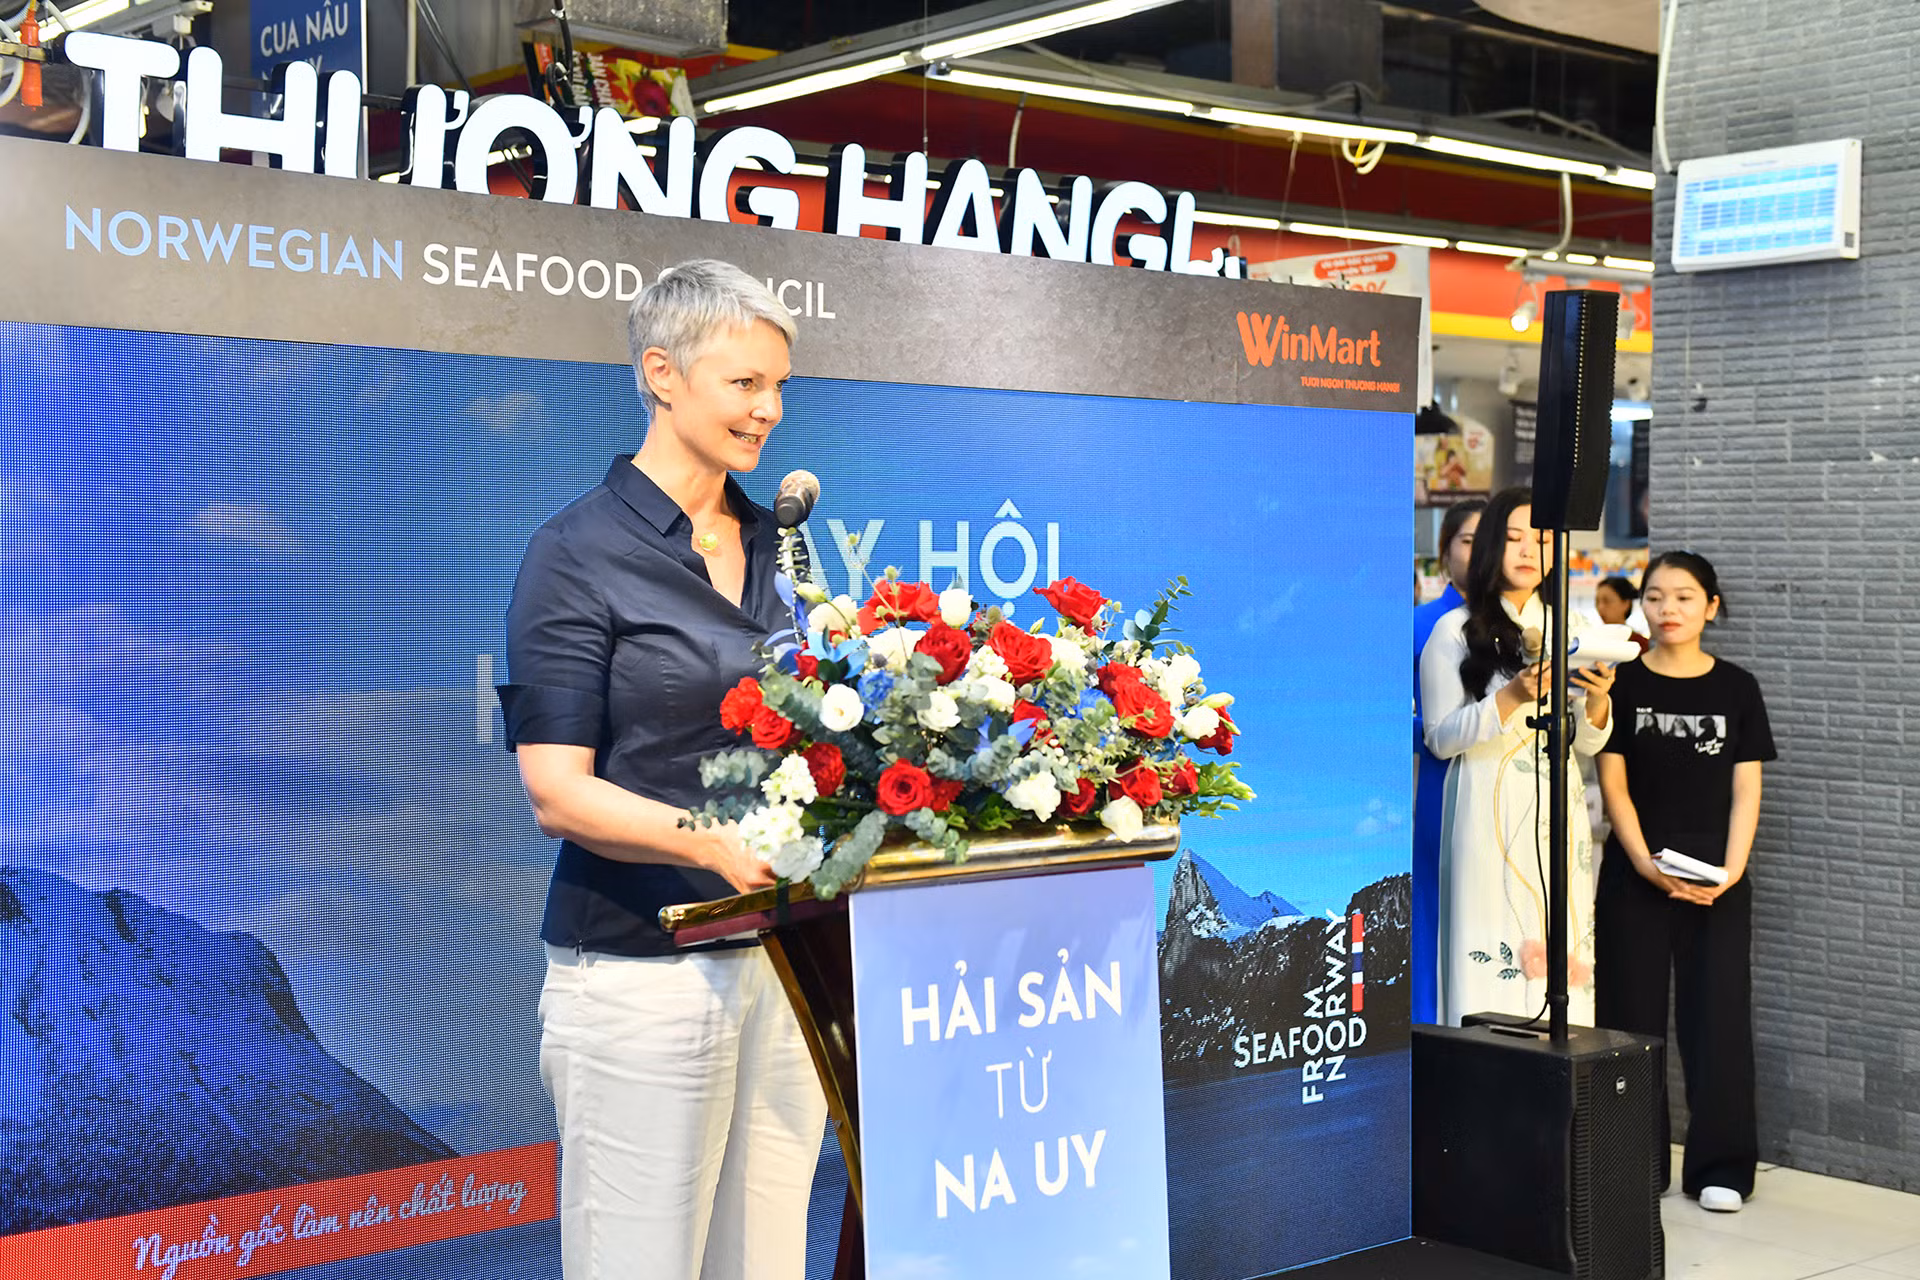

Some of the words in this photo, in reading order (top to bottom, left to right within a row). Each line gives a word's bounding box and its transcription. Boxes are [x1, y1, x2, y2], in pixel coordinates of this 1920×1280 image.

[260, 18, 300, 57] CUA
[305, 0, 348, 45] NÂU
[65, 204, 404, 280] NORWEGIAN
[422, 243, 643, 301] SEAFOOD
[1236, 311, 1382, 368] WinMart
[918, 497, 1060, 618] HỘI
[901, 959, 997, 1046] HẢI
[1017, 948, 1122, 1028] SẢN
[1234, 1015, 1368, 1069] SEAFOOD
[1325, 908, 1347, 1082] NORWAY
[985, 1046, 1053, 1119] TỪ
[1302, 985, 1325, 1105] FROM
[935, 1148, 1016, 1219] NA
[1034, 1128, 1107, 1197] UY
[133, 1214, 234, 1280] Nguồn
[236, 1205, 288, 1267] gốc
[348, 1194, 396, 1229] nên
[398, 1172, 456, 1219] chất
[460, 1173, 529, 1214] lượng
